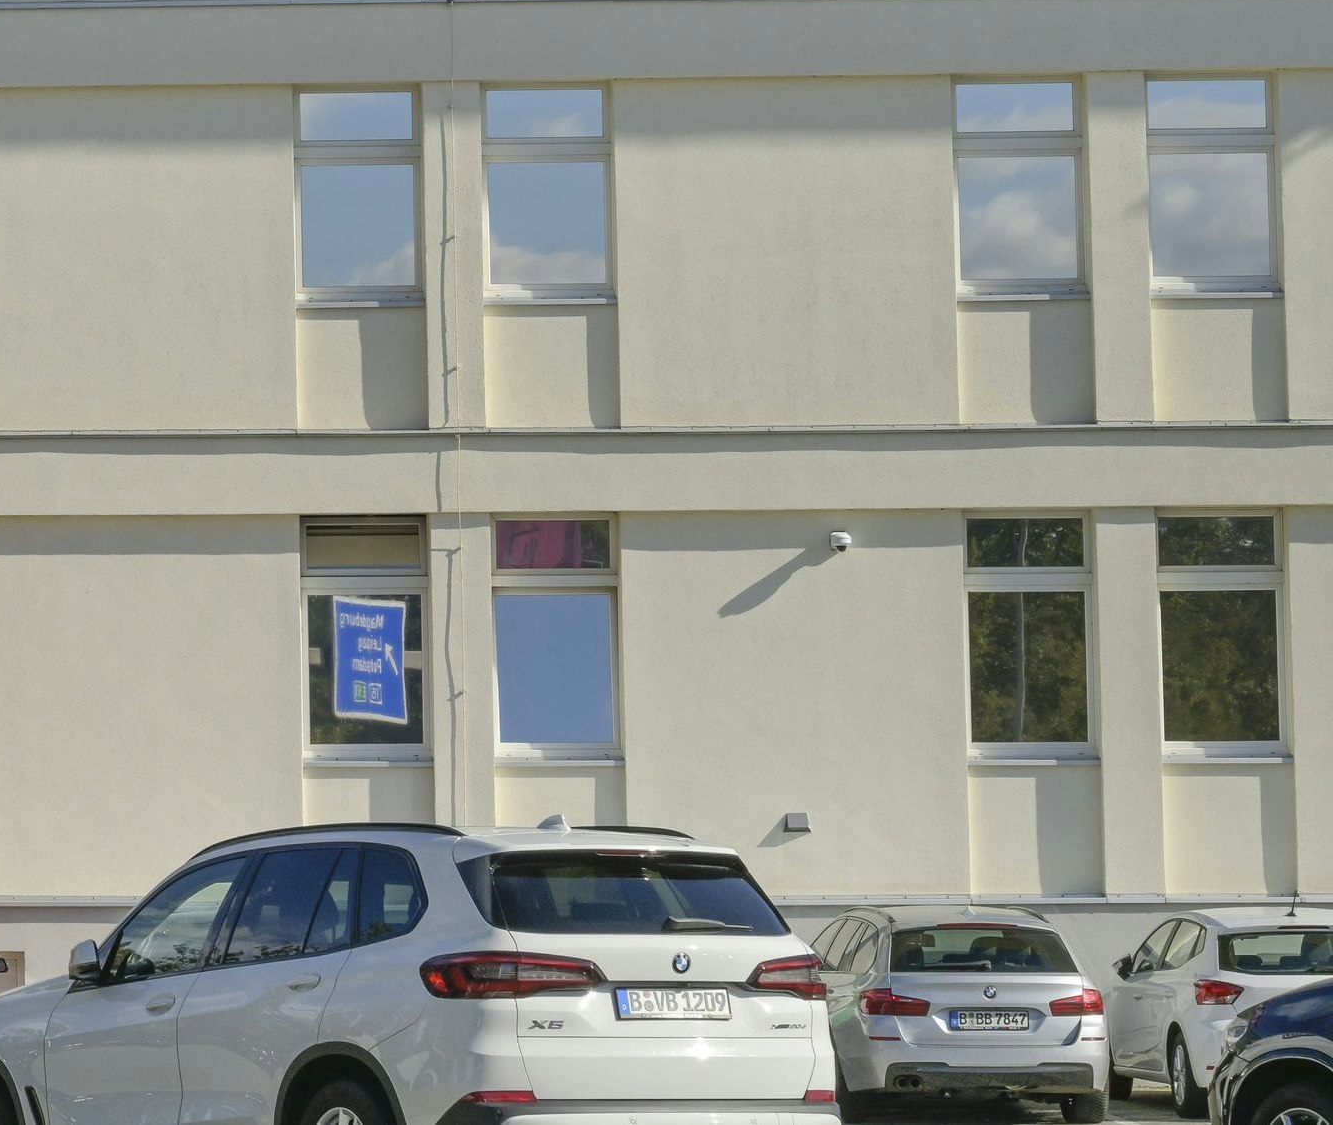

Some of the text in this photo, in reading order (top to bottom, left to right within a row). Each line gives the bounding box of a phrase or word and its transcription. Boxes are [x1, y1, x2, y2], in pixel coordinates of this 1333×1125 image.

[629, 991, 726, 1011] B VB 1209
[959, 1013, 1027, 1025] B BB 7847
